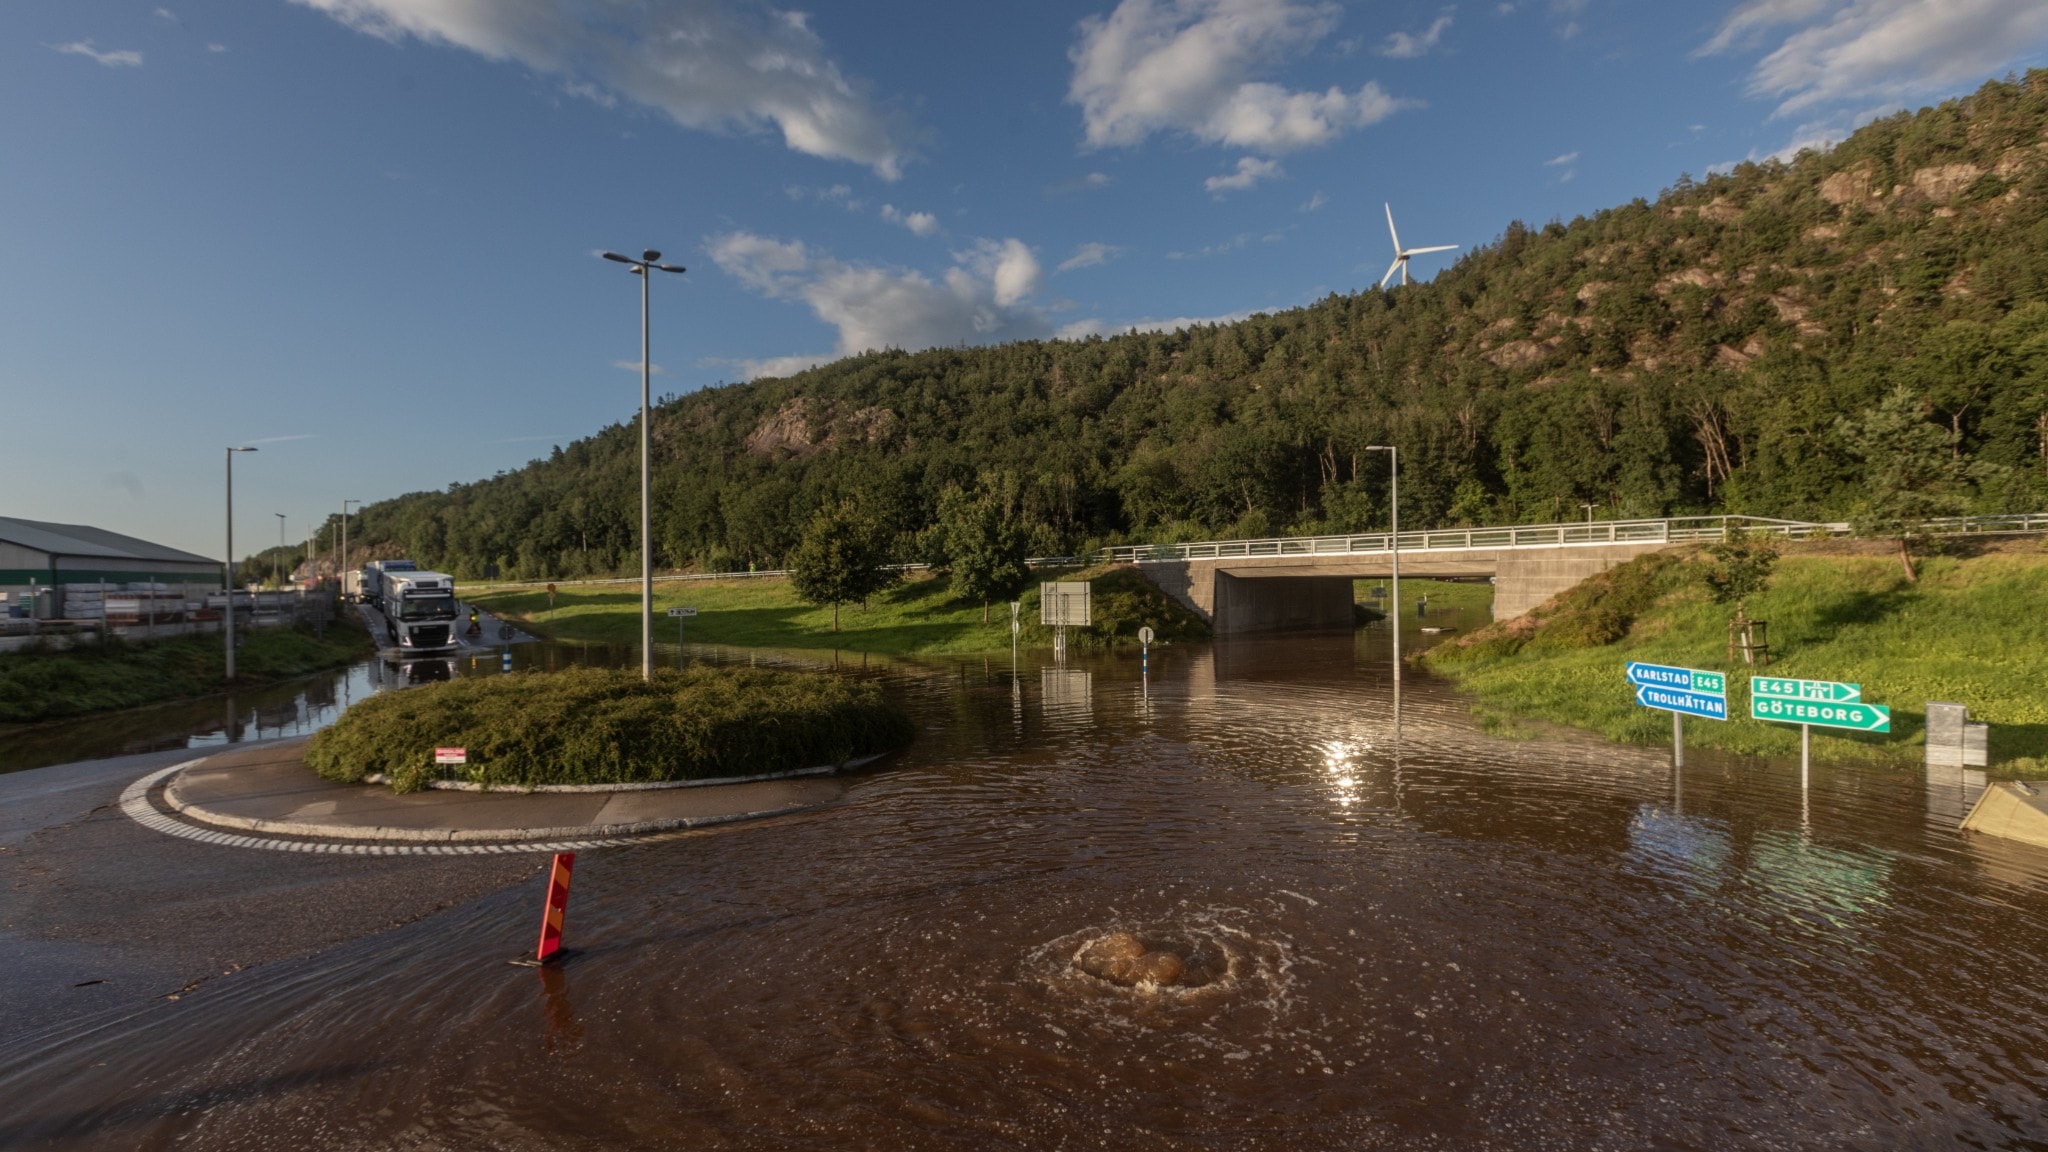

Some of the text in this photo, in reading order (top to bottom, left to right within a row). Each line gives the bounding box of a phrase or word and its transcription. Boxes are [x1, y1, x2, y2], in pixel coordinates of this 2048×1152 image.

[1636, 668, 1719, 689] KARLSTAD E45
[1760, 681, 1794, 694] E45
[1647, 691, 1723, 714] TROLLHÄTTAN
[1757, 701, 1864, 722] GÖTEBORG
